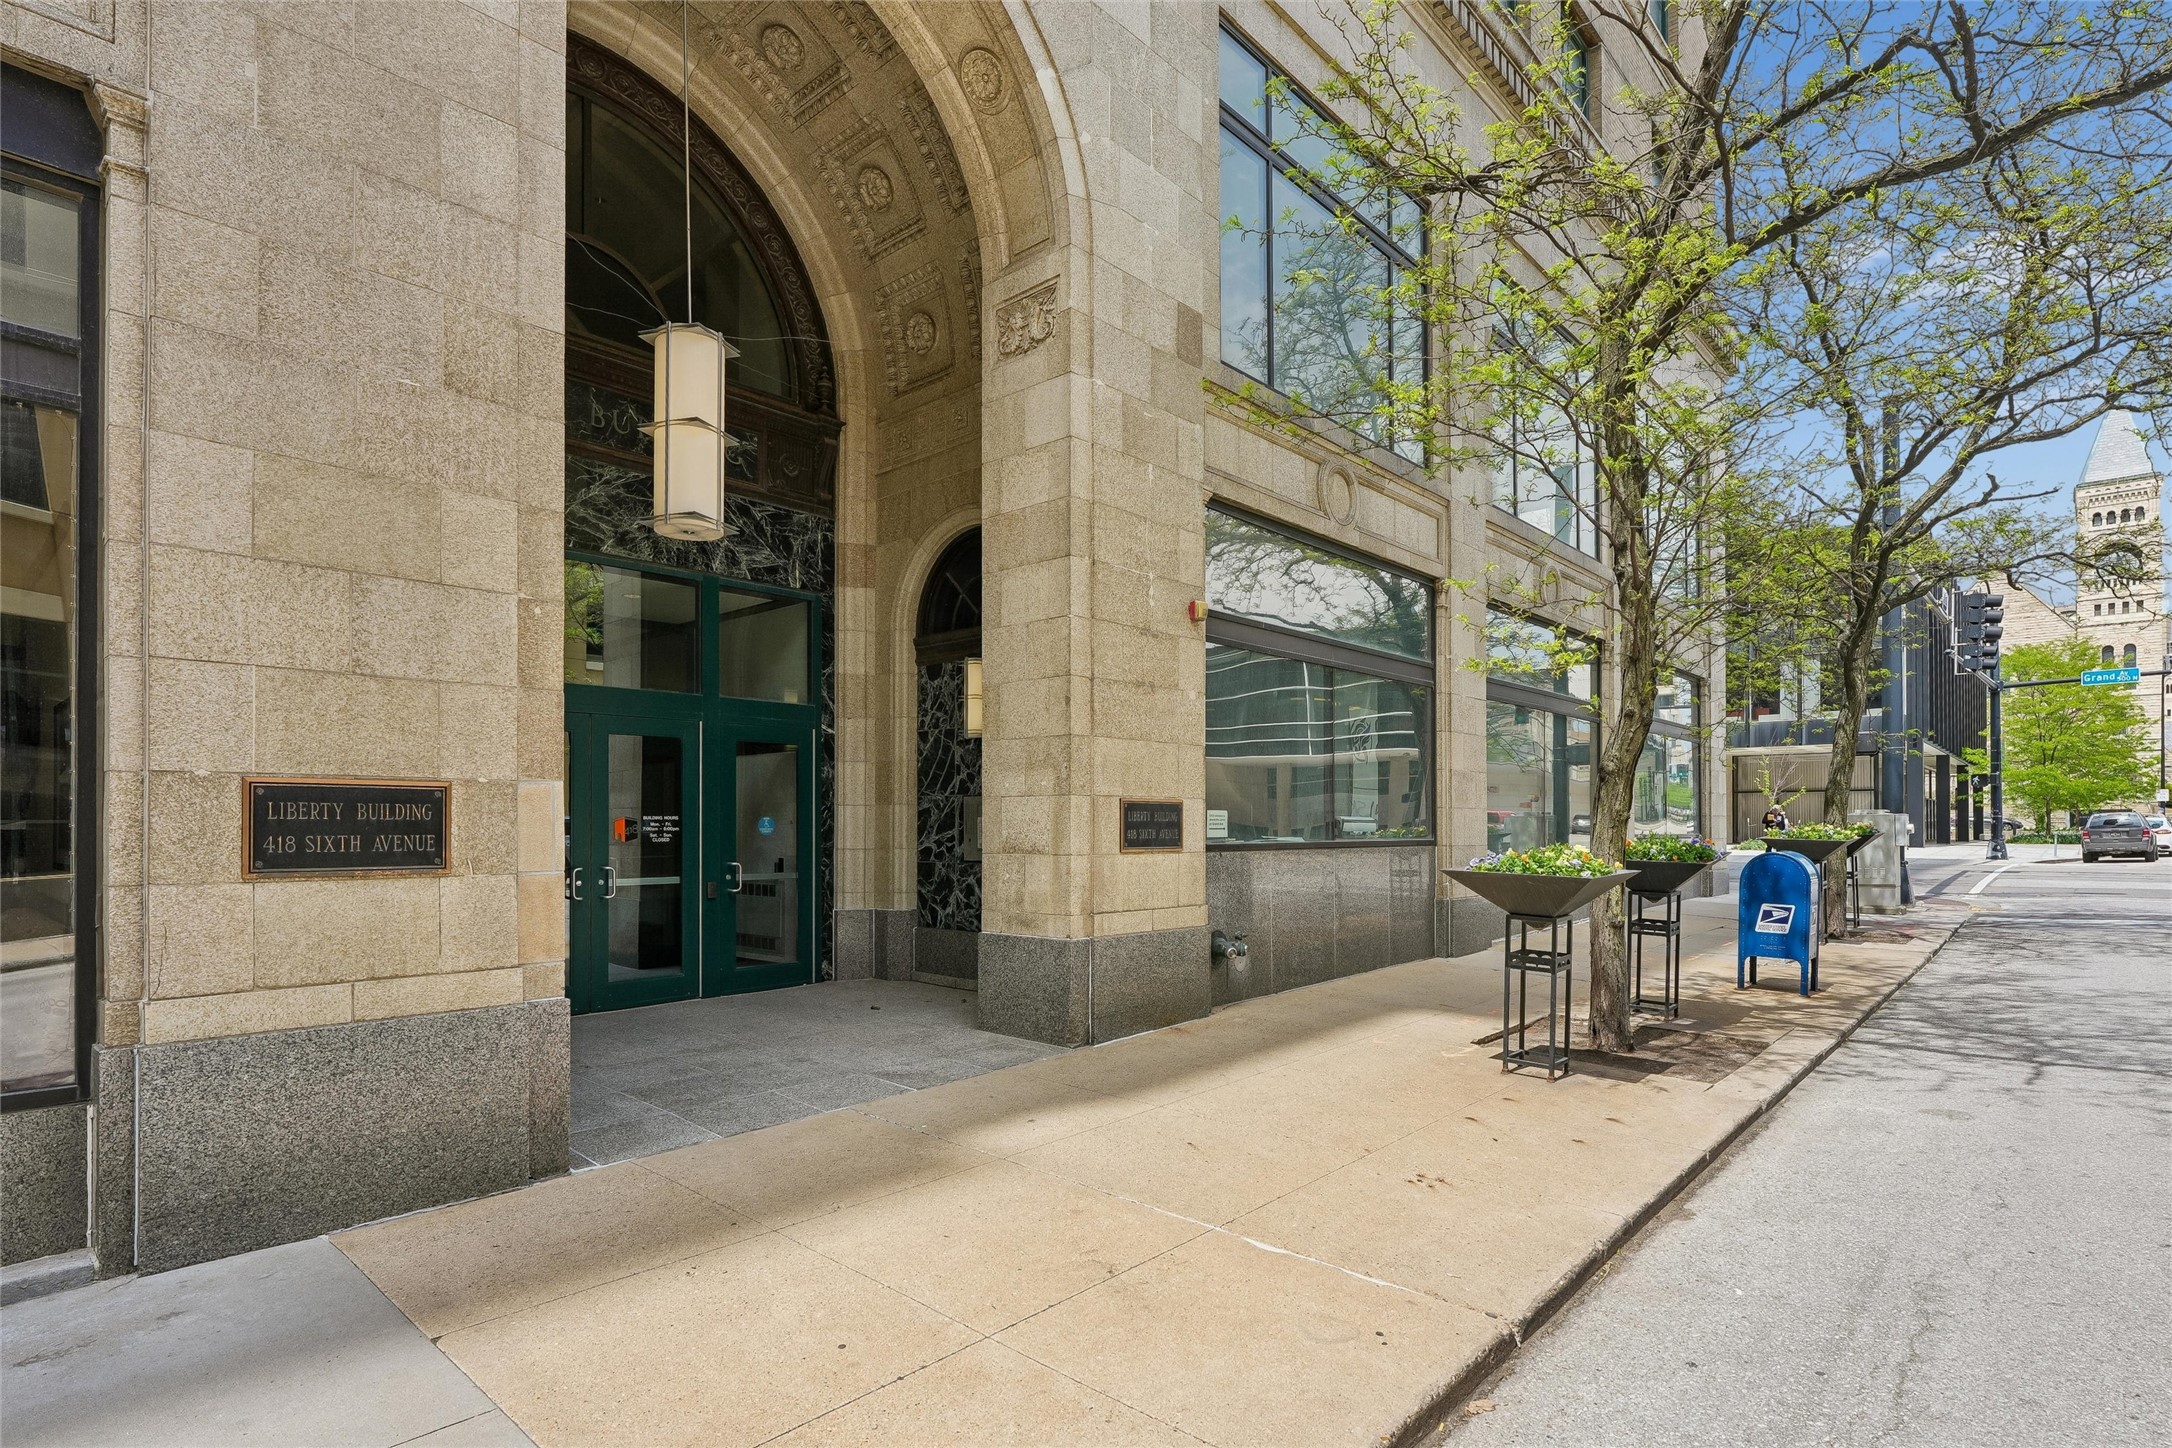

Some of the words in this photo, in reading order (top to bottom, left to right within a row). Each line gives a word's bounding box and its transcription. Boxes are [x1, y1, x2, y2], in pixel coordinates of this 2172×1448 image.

[2084, 673, 2115, 682] Grand
[267, 801, 344, 821] LIBERTY
[357, 803, 433, 821] BUILDING
[1127, 810, 1151, 822] LIBERTY
[1154, 811, 1178, 822] BUILDING
[1126, 829, 1137, 839] 418
[1138, 829, 1157, 839] SIXTH
[1159, 829, 1179, 839] AVENUE
[263, 835, 297, 854] 418
[305, 835, 361, 853] SIXTH
[372, 834, 436, 852] AVENUE
